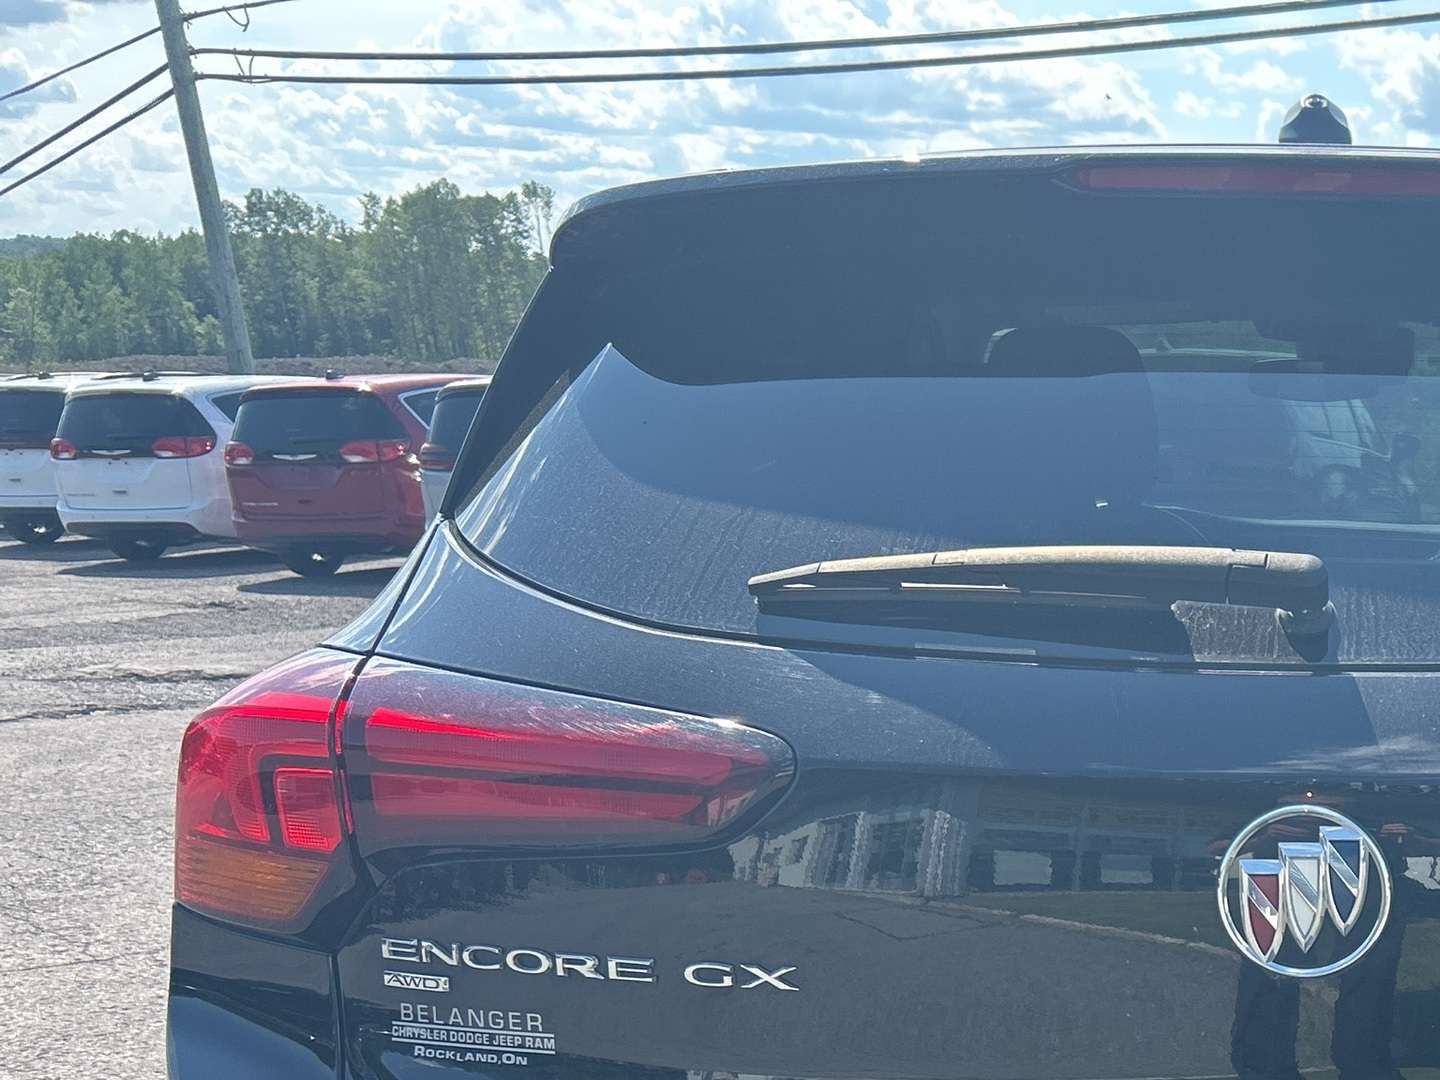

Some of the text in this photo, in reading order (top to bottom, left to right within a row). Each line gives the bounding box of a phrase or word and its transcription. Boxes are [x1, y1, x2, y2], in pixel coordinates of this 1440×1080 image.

[381, 937, 799, 991] ENCORE GX
[386, 973, 440, 990] AWD
[400, 1002, 544, 1032] BELANGER
[391, 1025, 556, 1050] CHRYSLER DODGE JEEP RAM
